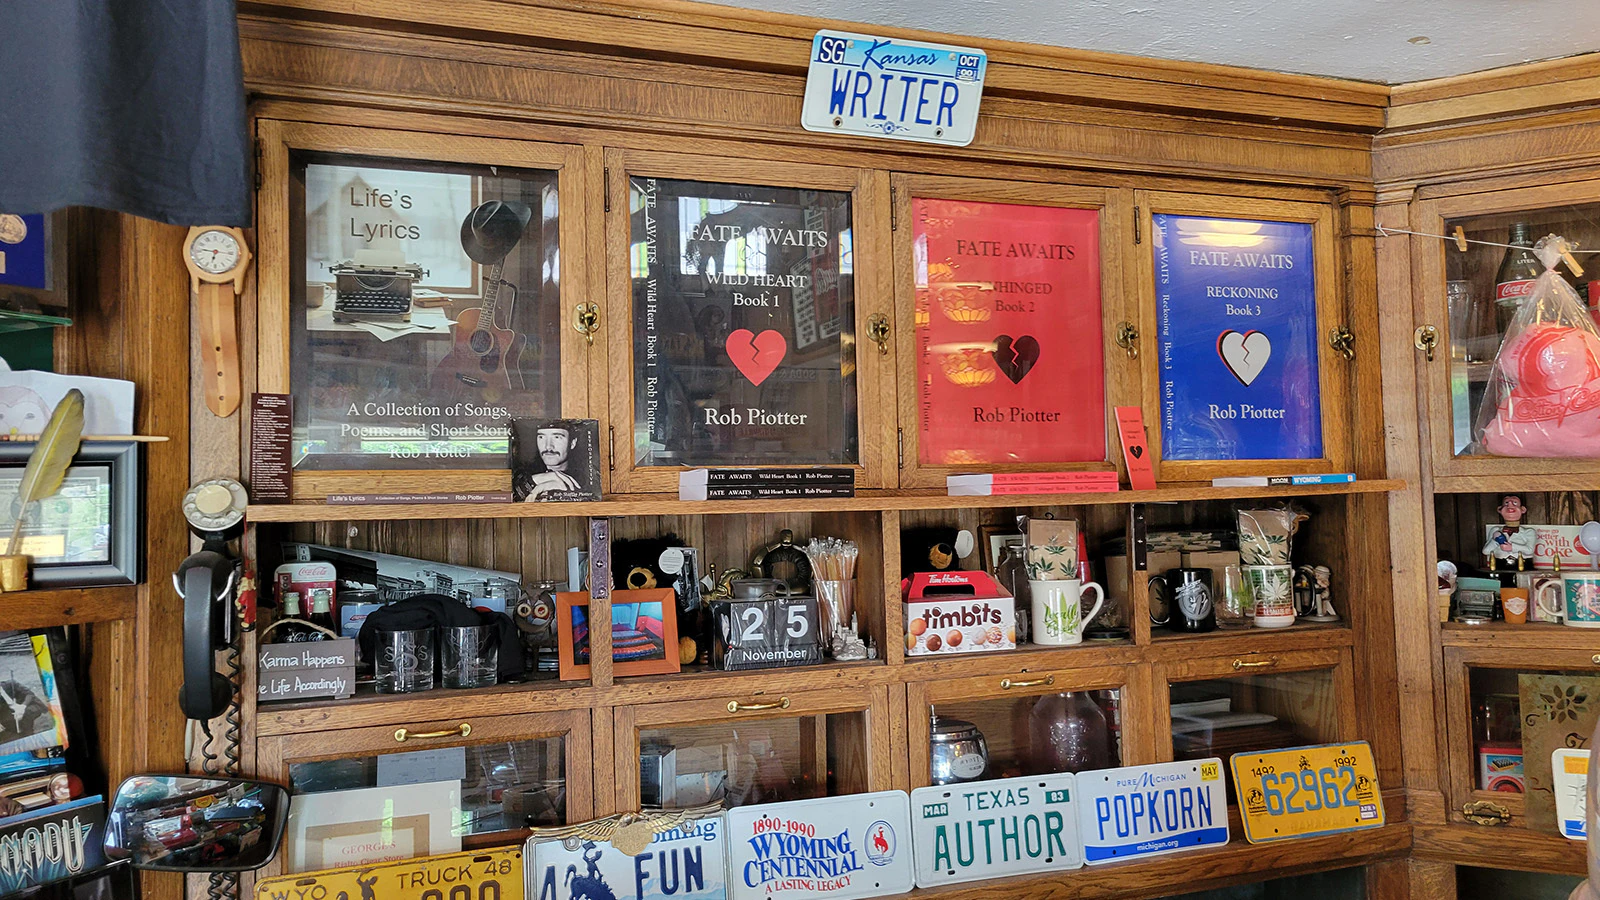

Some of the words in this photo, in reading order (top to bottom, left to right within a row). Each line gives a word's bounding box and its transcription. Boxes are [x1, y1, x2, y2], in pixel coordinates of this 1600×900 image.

[820, 38, 846, 63] SG
[862, 38, 941, 70] Kansas
[959, 55, 979, 67] OCT
[829, 68, 960, 127] WRITER
[350, 187, 413, 210] Life's
[647, 178, 656, 209] FATE
[350, 218, 421, 242] Lyrics
[688, 224, 741, 242] FATE
[646, 216, 657, 264] AWAITS
[956, 240, 1002, 257] FATE
[1006, 243, 1076, 260] AWAITS
[1160, 246, 1170, 285] AWAITS
[1190, 251, 1229, 267] FATE
[1233, 252, 1294, 270] AWAITS
[705, 270, 749, 286] WILD
[754, 274, 808, 288] HEART
[647, 279, 657, 302] Wild
[733, 293, 768, 307] Book
[773, 296, 780, 307] 1
[1206, 286, 1279, 300] RECKONING
[995, 300, 1026, 312] Book
[1028, 302, 1036, 312] 2
[1162, 294, 1171, 337] Reckoning
[1225, 304, 1252, 316] Book
[1255, 305, 1261, 316] 3
[647, 304, 657, 331] Heart
[647, 335, 657, 360] Book
[1164, 342, 1173, 363] Book
[647, 376, 658, 398] Rob
[1165, 381, 1175, 399] Rob
[347, 403, 361, 416] A
[364, 402, 441, 417] Collection
[445, 402, 460, 416] of
[464, 402, 512, 420] Songs,
[647, 401, 658, 435] Piotter
[704, 408, 742, 426] Rob
[747, 408, 808, 426] Piotter
[973, 407, 1005, 423] Rob
[1009, 407, 1061, 423] Piotter
[1166, 401, 1175, 431] Piotter
[1209, 404, 1237, 420] Rob
[1240, 404, 1286, 420] Piotter
[401, 424, 427, 437] and
[431, 423, 469, 437] Short
[1293, 476, 1322, 484] WYOMING
[1534, 543, 1573, 557] Coke
[1544, 537, 1570, 547] with
[929, 574, 942, 584] Tim
[741, 606, 765, 642] 2
[785, 605, 809, 638] 5
[922, 603, 1002, 629] timbits
[259, 651, 299, 669] Karma
[302, 650, 345, 668] Happens
[742, 648, 807, 662] November
[271, 679, 291, 695] Life
[294, 676, 346, 694] Accordingly
[1202, 766, 1218, 777] MAY
[1333, 756, 1357, 768] 1992
[1117, 778, 1137, 787] PURE
[1134, 772, 1187, 791] MICHIGAN
[1251, 766, 1275, 778] 1492
[963, 787, 1030, 811] TEXAS
[1261, 766, 1361, 816] 62962
[924, 805, 948, 817] MAR
[1096, 785, 1213, 841] POPKORN
[753, 817, 815, 838] 1890-1990
[748, 828, 852, 861] WYOMING
[934, 811, 1067, 872] AUTHOR
[1136, 840, 1179, 850] michigan.org
[396, 864, 473, 889] TRUCK
[484, 860, 512, 876] 48
[634, 845, 704, 900] FUN
[744, 850, 864, 888] CENTENNIAL
[765, 884, 773, 894] A
[775, 879, 814, 893] LASTING
[817, 875, 851, 891] LEGACY
